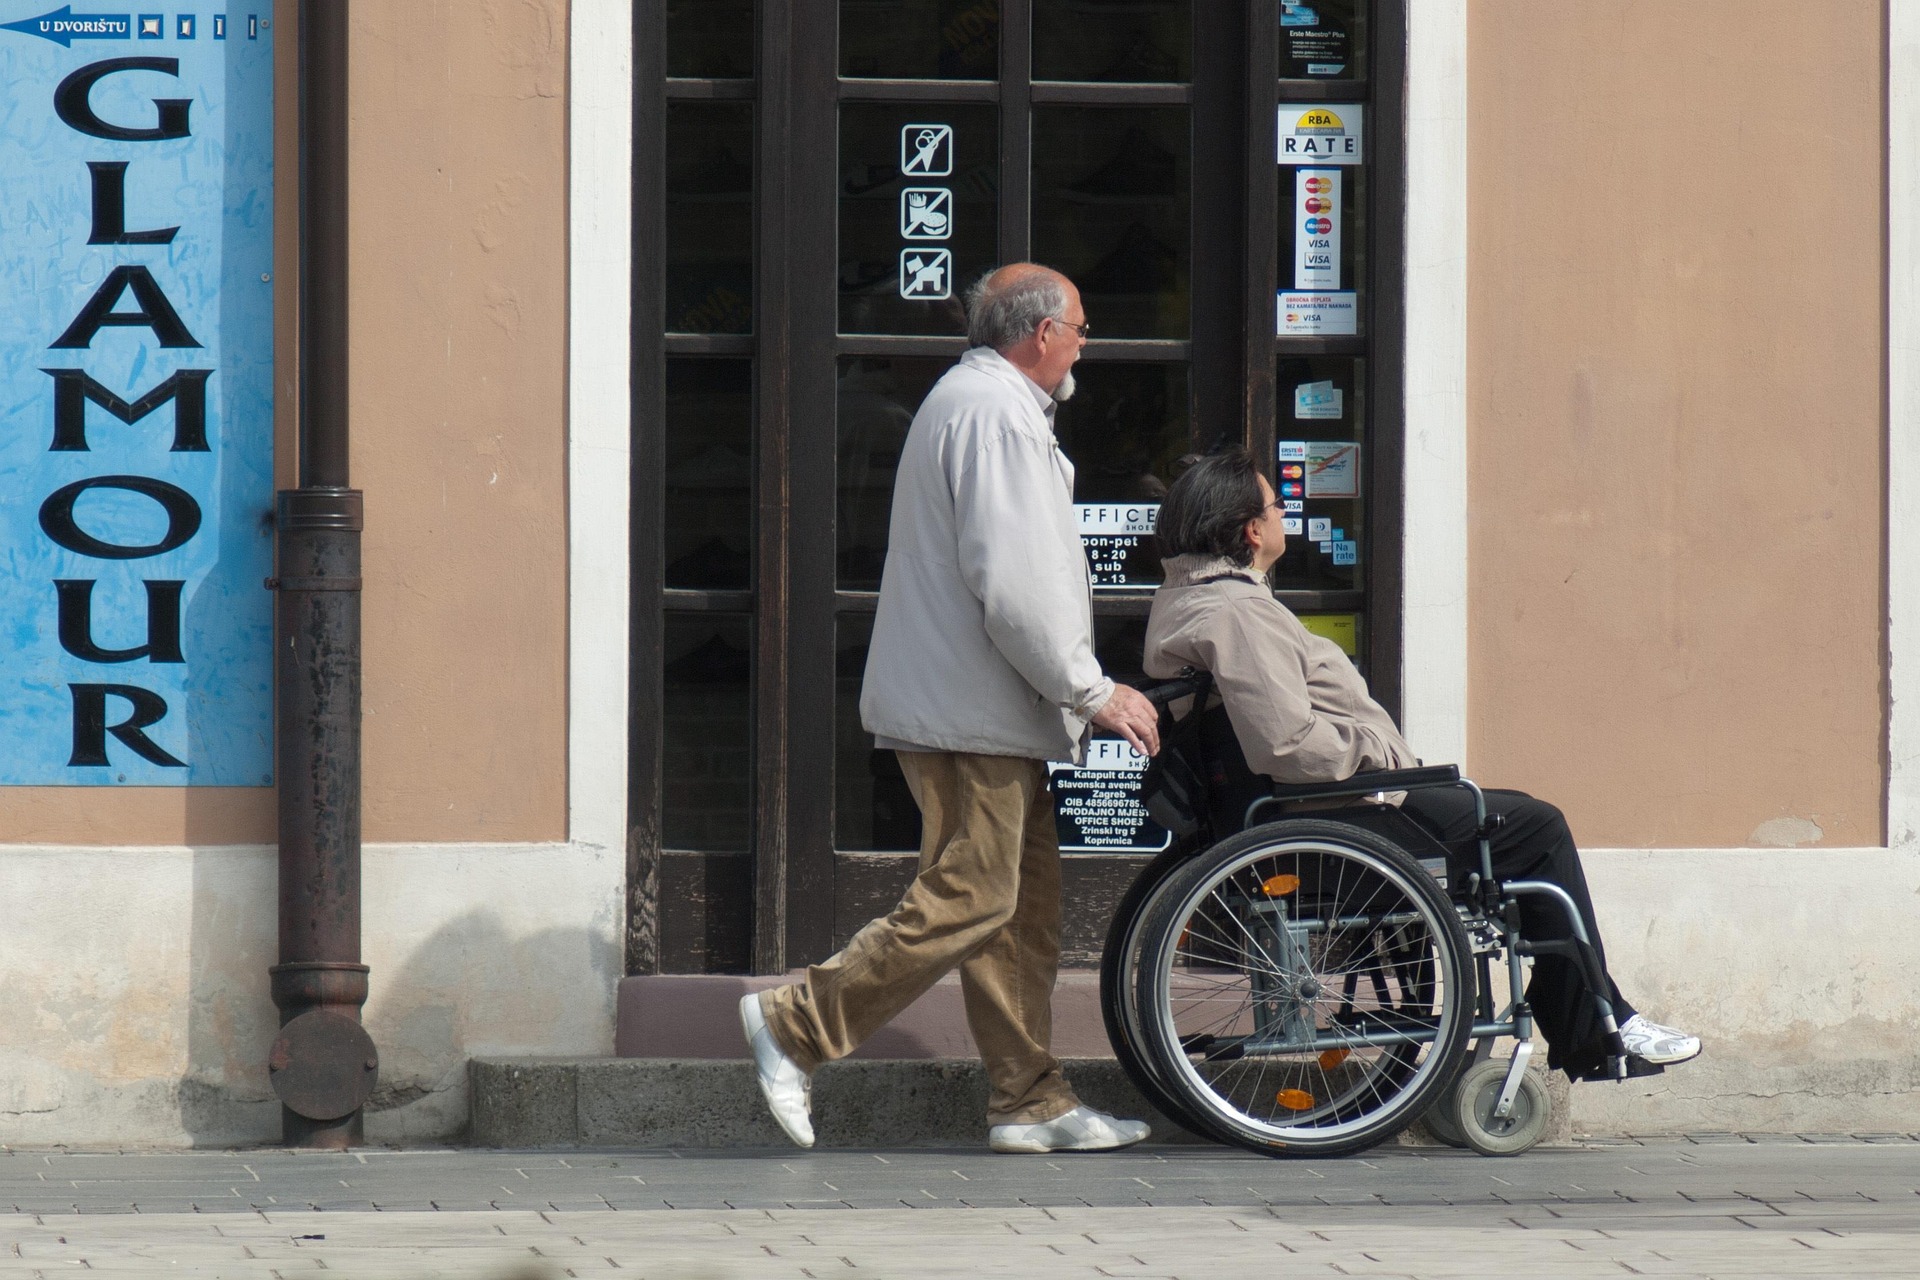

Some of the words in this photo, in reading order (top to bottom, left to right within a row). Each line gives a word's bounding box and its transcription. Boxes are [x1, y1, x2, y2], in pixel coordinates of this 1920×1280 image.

[39, 20, 52, 33] U
[53, 18, 127, 33] DVORIŠTU
[1308, 115, 1331, 125] RBA
[1285, 137, 1354, 153] RATE
[1308, 239, 1330, 248] VISA
[1308, 255, 1330, 264] VISA
[1303, 314, 1321, 322] VISA
[38, 56, 216, 768] GLAMOUR
[1284, 502, 1302, 510] VISA
[1082, 508, 1155, 523] FFICE
[1081, 536, 1138, 549] pon-pet
[1335, 543, 1348, 552] Na
[1091, 550, 1099, 560] 8
[1111, 550, 1127, 560] 20
[1335, 551, 1355, 560] rate
[1095, 561, 1122, 571] sub
[1091, 574, 1098, 584] 8
[1111, 574, 1126, 584] 13
[1074, 770, 1116, 781] Katapult
[1057, 780, 1106, 789] Slavonska
[1107, 781, 1141, 791] avenija
[1092, 790, 1126, 800] Zagreb
[1064, 798, 1083, 807] OIB
[1060, 807, 1116, 817] PRODAJNO
[1117, 808, 1150, 817] MJEST
[1074, 817, 1109, 826] OFFICE
[1110, 818, 1144, 826] SHOES
[1081, 826, 1113, 835] Zrinski
[1114, 827, 1128, 837] trg
[1130, 827, 1136, 835] 5
[1084, 836, 1133, 846] Koprivnica
